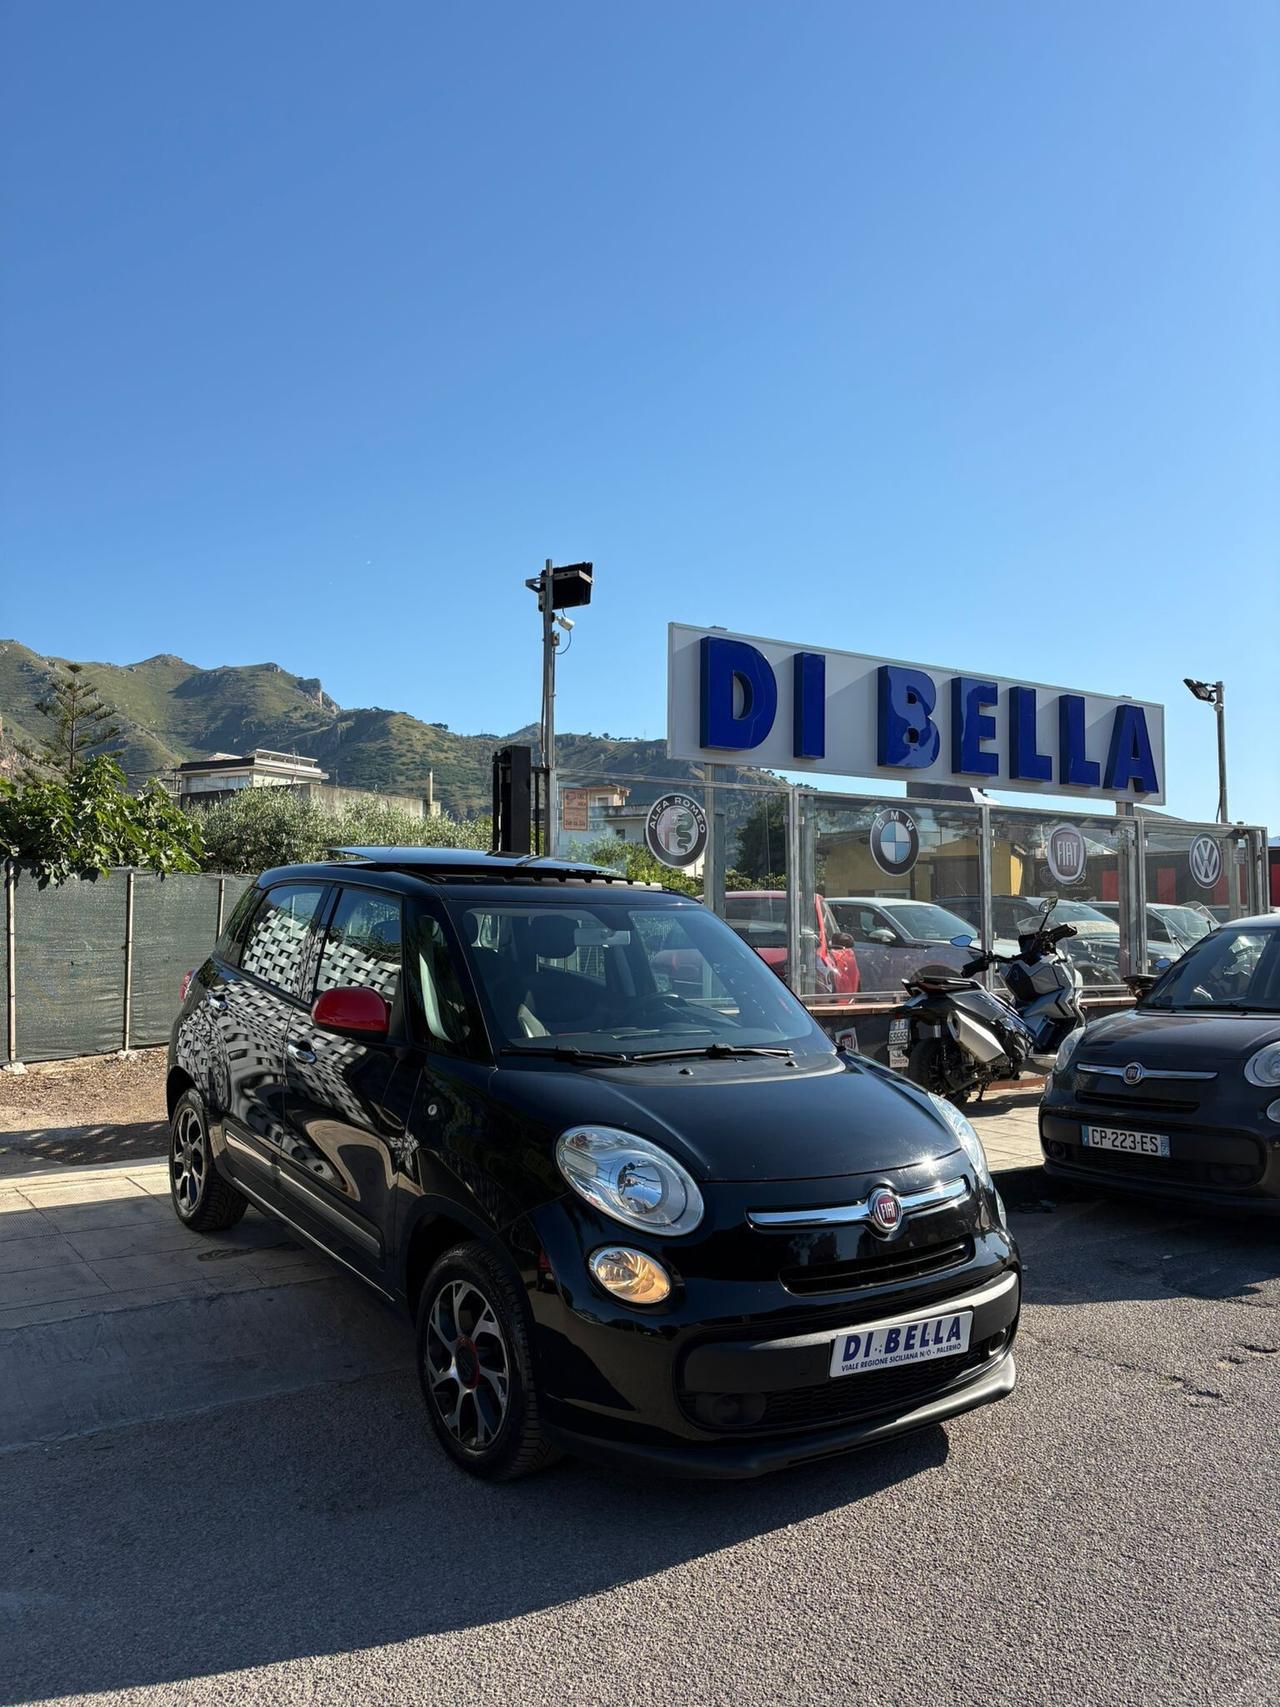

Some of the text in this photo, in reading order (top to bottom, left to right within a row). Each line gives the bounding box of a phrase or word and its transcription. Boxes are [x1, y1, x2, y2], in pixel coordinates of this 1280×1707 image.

[700, 636, 1159, 793] DI BELLA
[650, 797, 706, 833] ALFA ROMEO
[875, 811, 914, 831] BMW
[1057, 841, 1078, 866] FIAT
[1091, 1128, 1159, 1153] CP-223-ES
[880, 1201, 896, 1219] FIAT
[842, 1317, 961, 1362] DI BELLA
[841, 1361, 859, 1372] VIALE
[860, 1356, 888, 1368] REGIONE
[889, 1351, 918, 1363] SICILIANA
[936, 1343, 962, 1354] PALERMO
